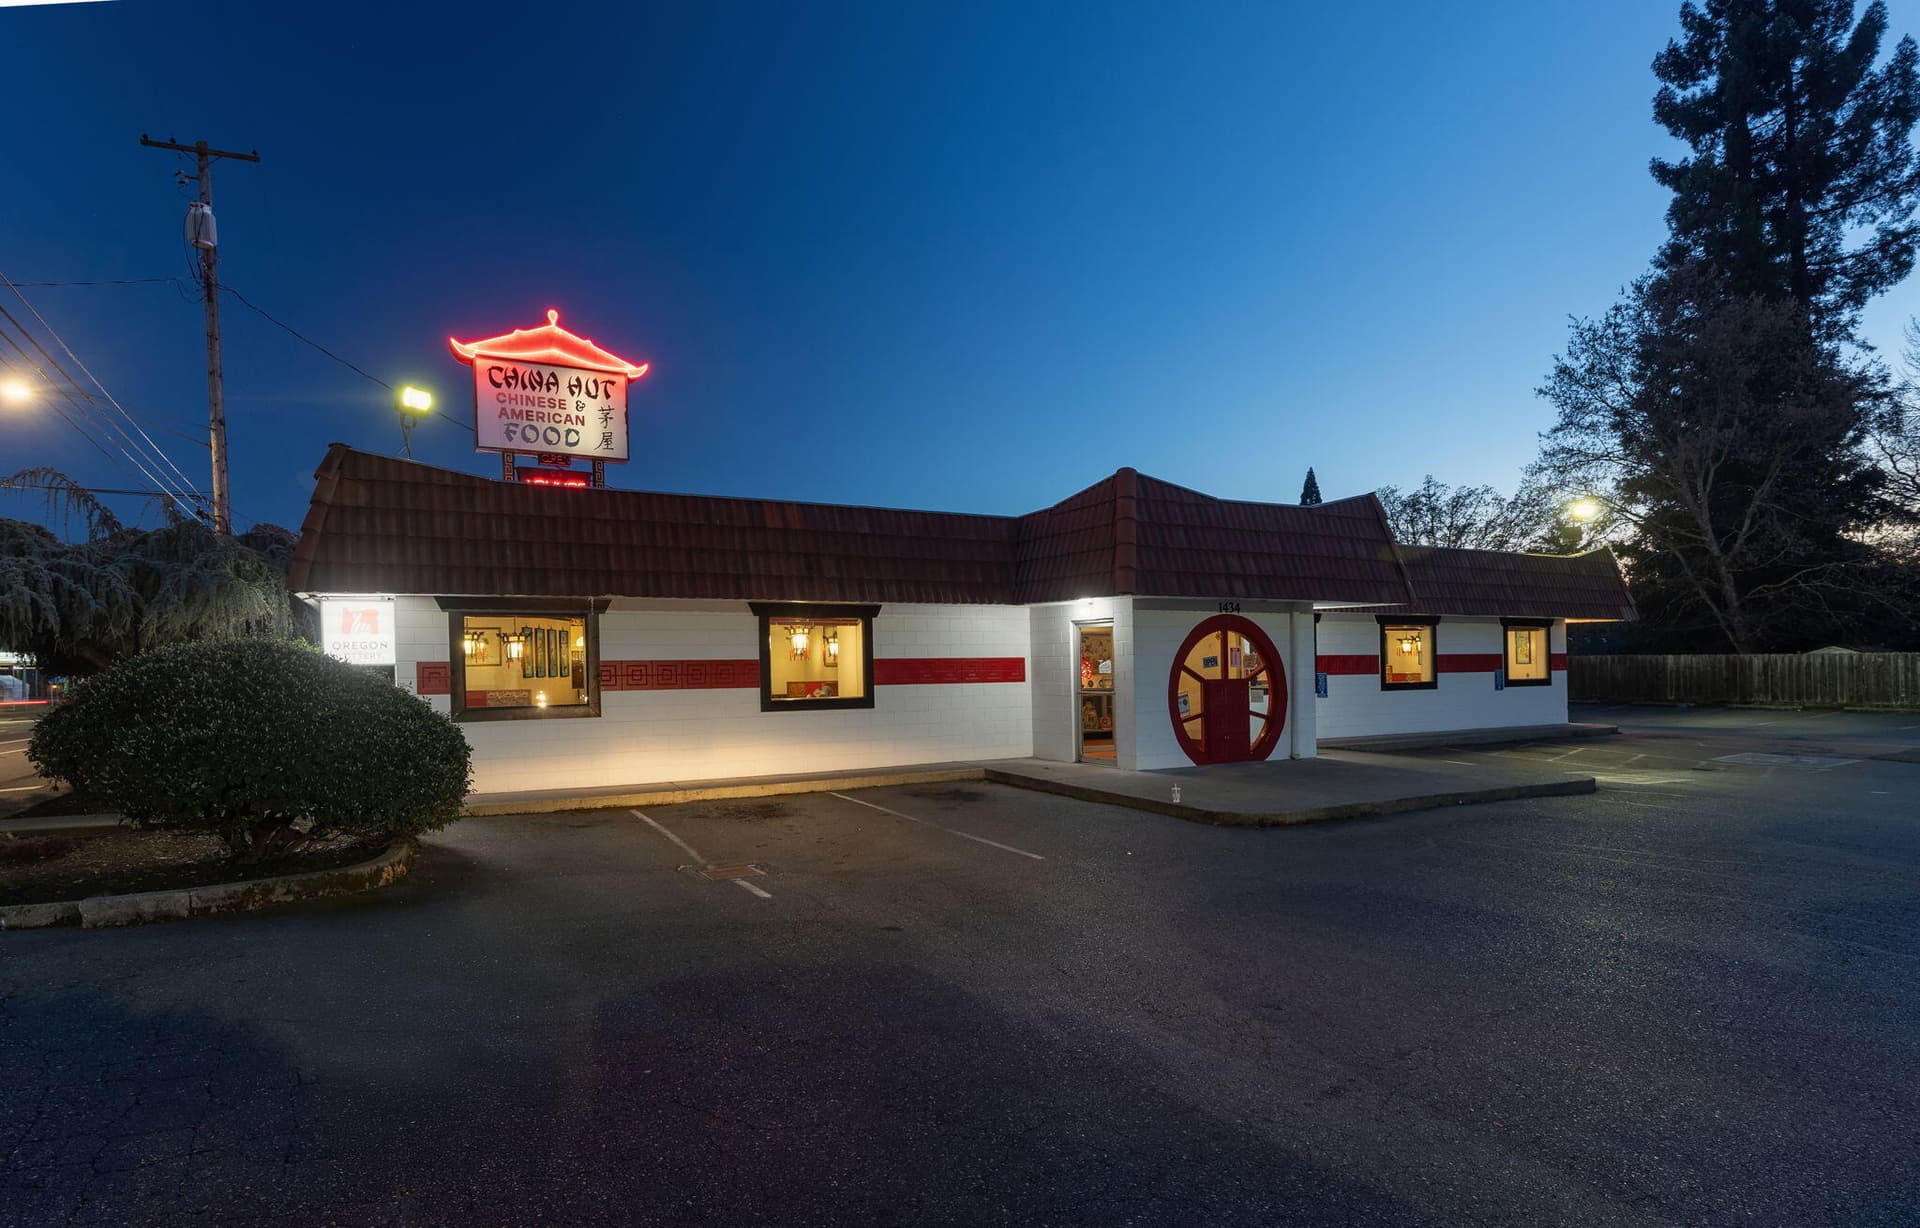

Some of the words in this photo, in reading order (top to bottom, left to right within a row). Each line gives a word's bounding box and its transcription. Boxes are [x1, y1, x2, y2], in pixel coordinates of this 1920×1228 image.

[487, 366, 559, 395] CHINA
[567, 376, 616, 400] HUT
[496, 392, 567, 410] CHINESE
[575, 400, 586, 412] &
[498, 408, 586, 427] AMERICAN
[504, 422, 580, 447] FOOD
[1218, 602, 1240, 614] 1434
[332, 641, 388, 650] OREGON
